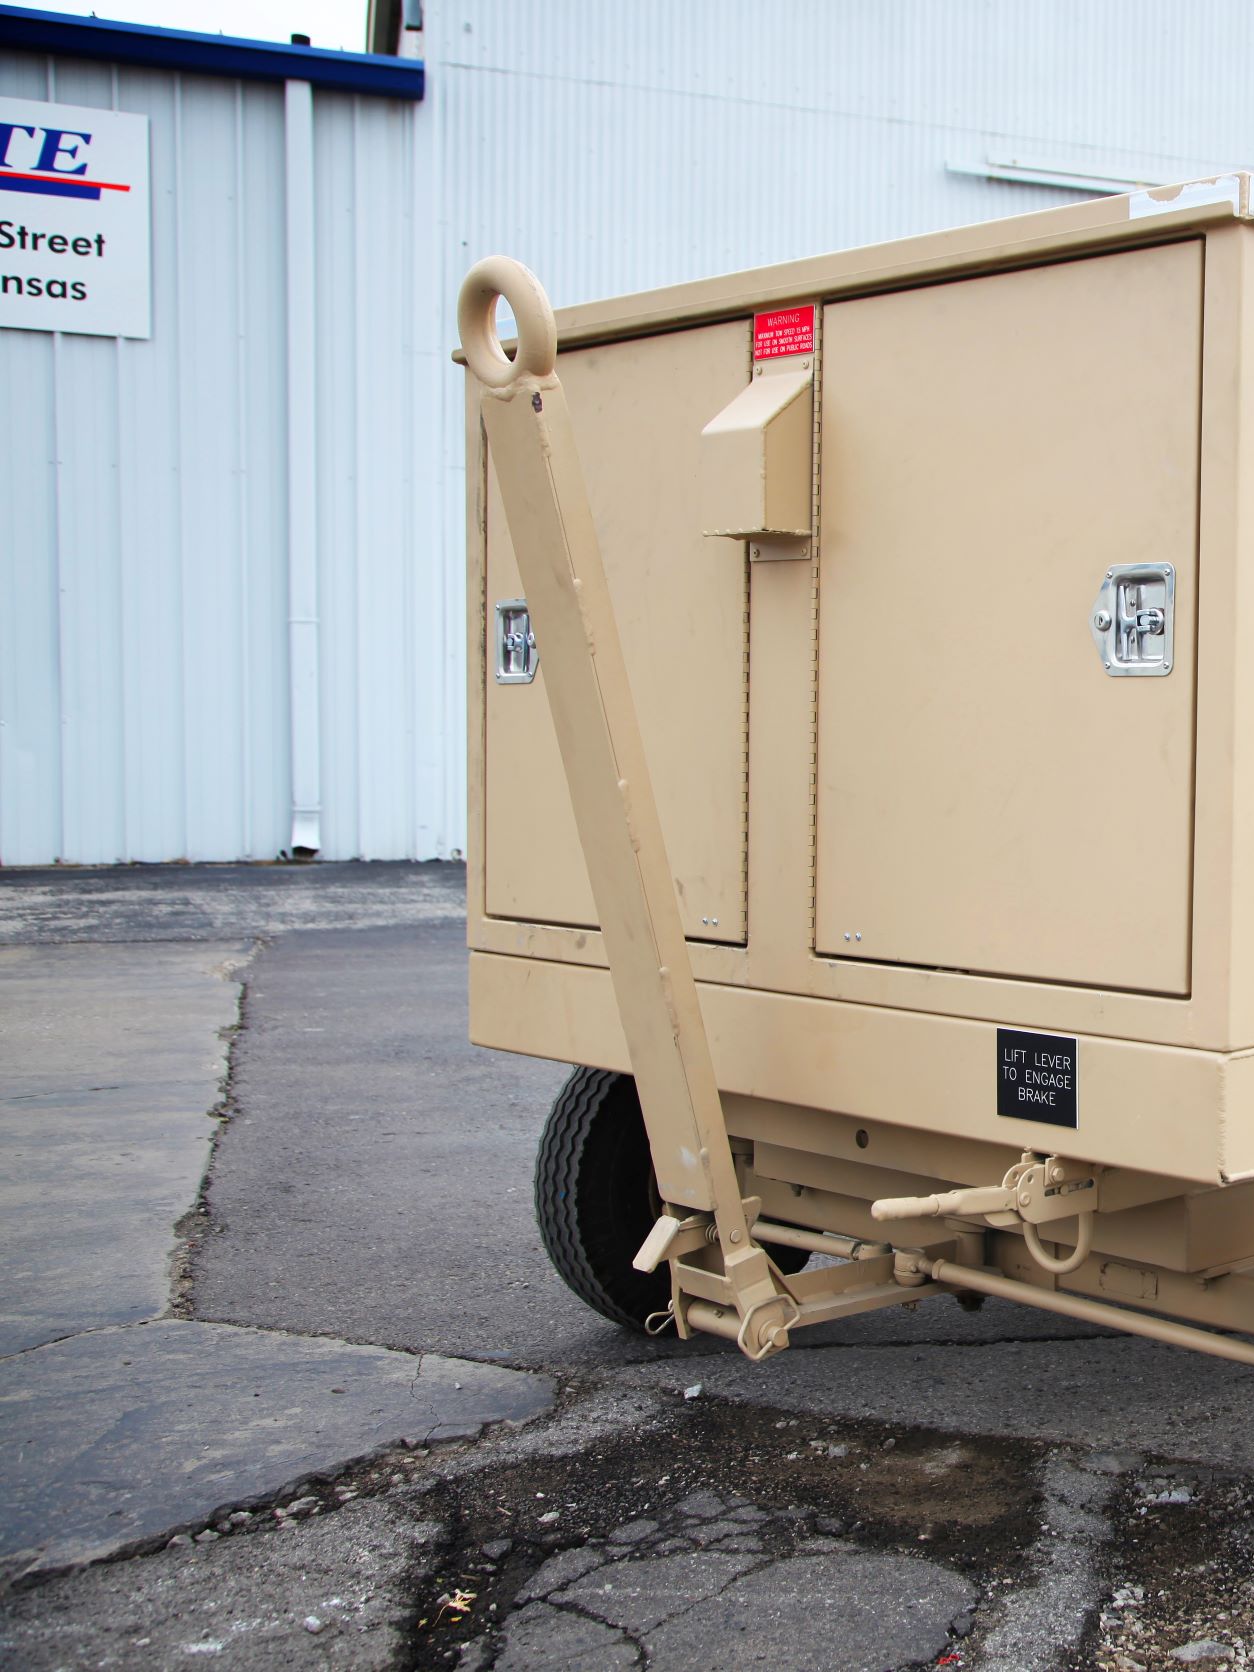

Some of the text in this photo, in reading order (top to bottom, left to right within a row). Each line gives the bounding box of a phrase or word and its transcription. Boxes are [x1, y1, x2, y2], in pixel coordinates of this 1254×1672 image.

[0, 122, 92, 175] TE
[0, 220, 105, 257] Street
[1, 275, 87, 301] nsas
[767, 314, 800, 327] WARNING
[784, 327, 795, 335] SPEED
[787, 343, 799, 351] PUBLIC
[800, 341, 812, 350] ROADS
[794, 334, 812, 342] SURFACES
[1004, 1047, 1071, 1071] LIFT LEVER
[1002, 1065, 1072, 1090] TO ENGAGE
[1018, 1086, 1056, 1106] BRAKE
